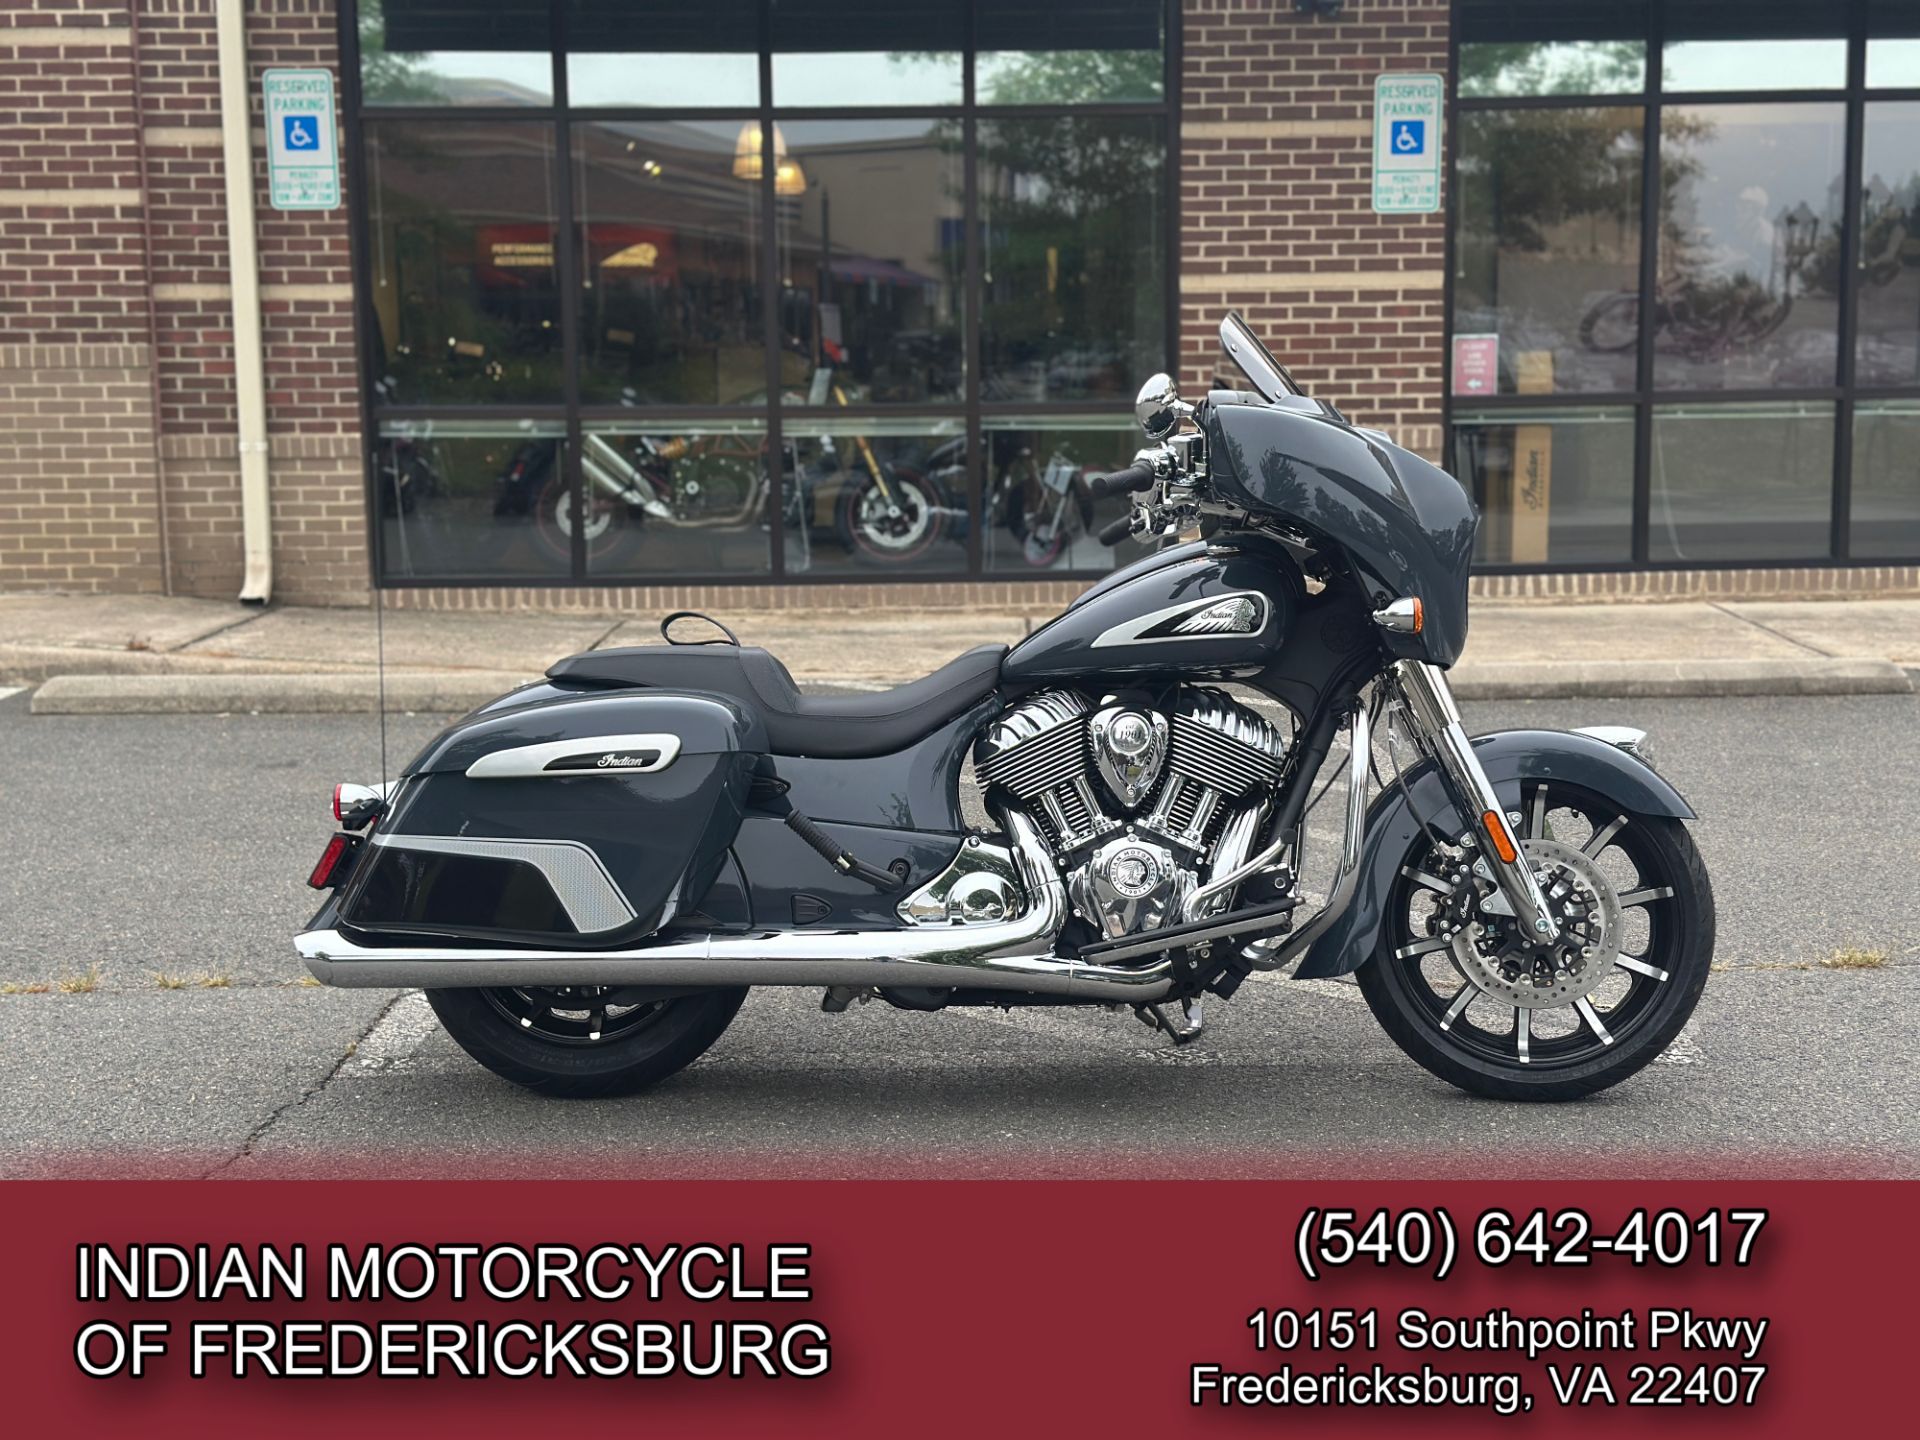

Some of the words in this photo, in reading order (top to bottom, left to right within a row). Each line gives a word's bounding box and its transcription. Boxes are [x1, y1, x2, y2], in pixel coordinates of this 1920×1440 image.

[267, 80, 327, 93] RESERVED
[1380, 85, 1437, 98] RESERVED
[274, 98, 325, 111] PARKING
[1384, 102, 1433, 115] PARKING
[1521, 450, 1538, 510] Indian
[1201, 610, 1233, 620] Indian
[597, 754, 643, 767] Indian
[1111, 855, 1122, 887] INDIAN
[1123, 849, 1155, 887] MOTORCYCLE
